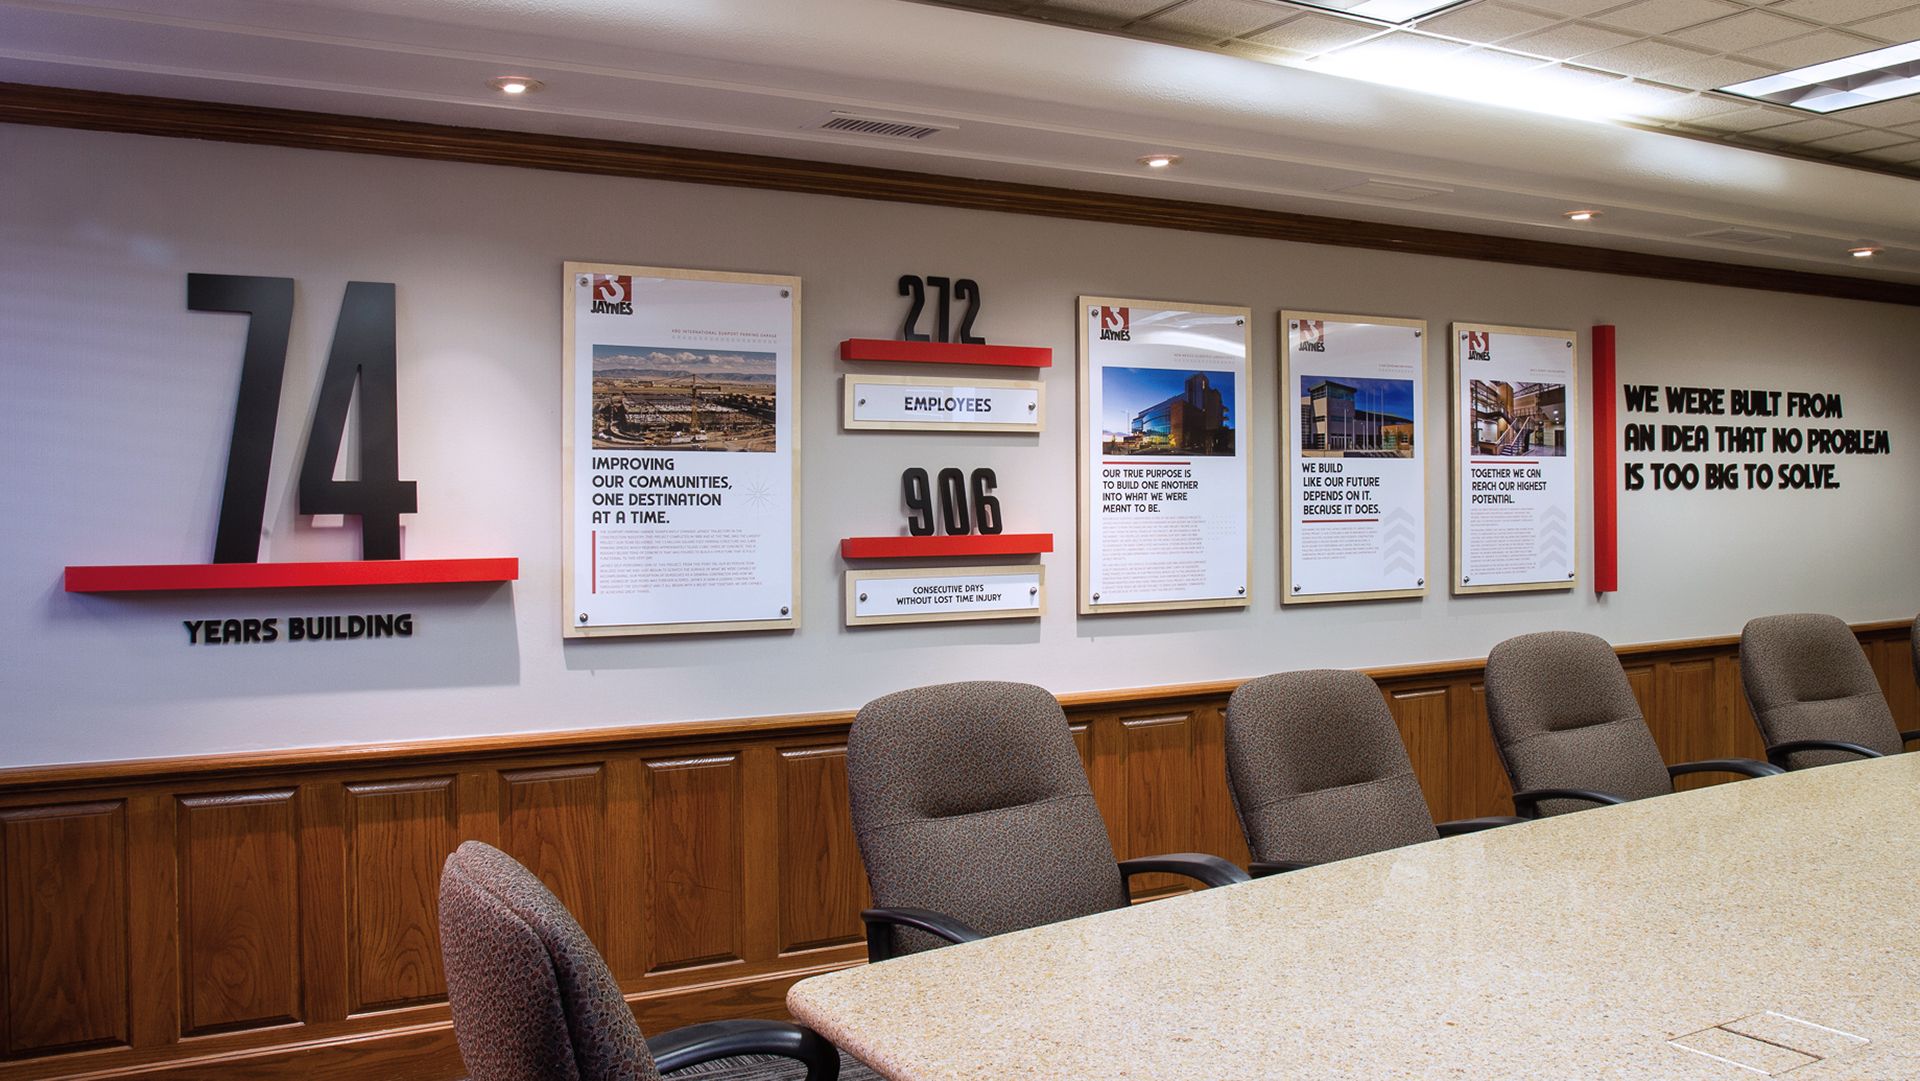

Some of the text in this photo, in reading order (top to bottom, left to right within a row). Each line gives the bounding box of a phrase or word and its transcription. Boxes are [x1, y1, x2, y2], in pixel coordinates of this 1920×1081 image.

[591, 301, 633, 315] JAYNES
[899, 275, 986, 345] 272
[1100, 329, 1130, 342] JAYNES
[1299, 342, 1325, 352] JAYNES
[1468, 351, 1490, 361] JAYNES
[905, 397, 991, 412] EMPLOYEES
[1624, 385, 1842, 419] WE WERE BUILT FROM
[188, 273, 418, 563] 74
[1625, 424, 1890, 455] AN IDEA THAT NO PROBLEM
[593, 457, 674, 470] IMPROVING
[1302, 463, 1343, 473] WE BUILD
[1103, 469, 1120, 477] OUR
[1123, 469, 1143, 478] TRUE
[1146, 470, 1182, 478] PURPOSE
[1471, 469, 1541, 478] TOGETHER WE CAN
[1625, 463, 1840, 491] IS TOO BIG TO SOLVE.
[592, 475, 732, 489] OUR COMMUNITIES,
[1103, 481, 1198, 489] TO BUILD ONE ANOTHER
[1304, 477, 1379, 487] LIKE OUR FUTURE
[1472, 481, 1546, 491] REACH OUR HIGHEST
[592, 493, 721, 506] ONE DESTINATION
[1103, 493, 1122, 501] INTO
[1304, 491, 1371, 501] DEPENDS ON IT.
[1472, 494, 1514, 504] POTENTIAL.
[903, 468, 1002, 536] 906
[1103, 504, 1160, 512] MEANT TO BE.
[1304, 504, 1380, 515] BECAUSE IT DOES.
[593, 511, 669, 523] AT A TIME.
[913, 585, 962, 594] CONSECUTIVE
[897, 596, 931, 605] WITHOUT
[183, 614, 412, 644] YEARS BUILDING
